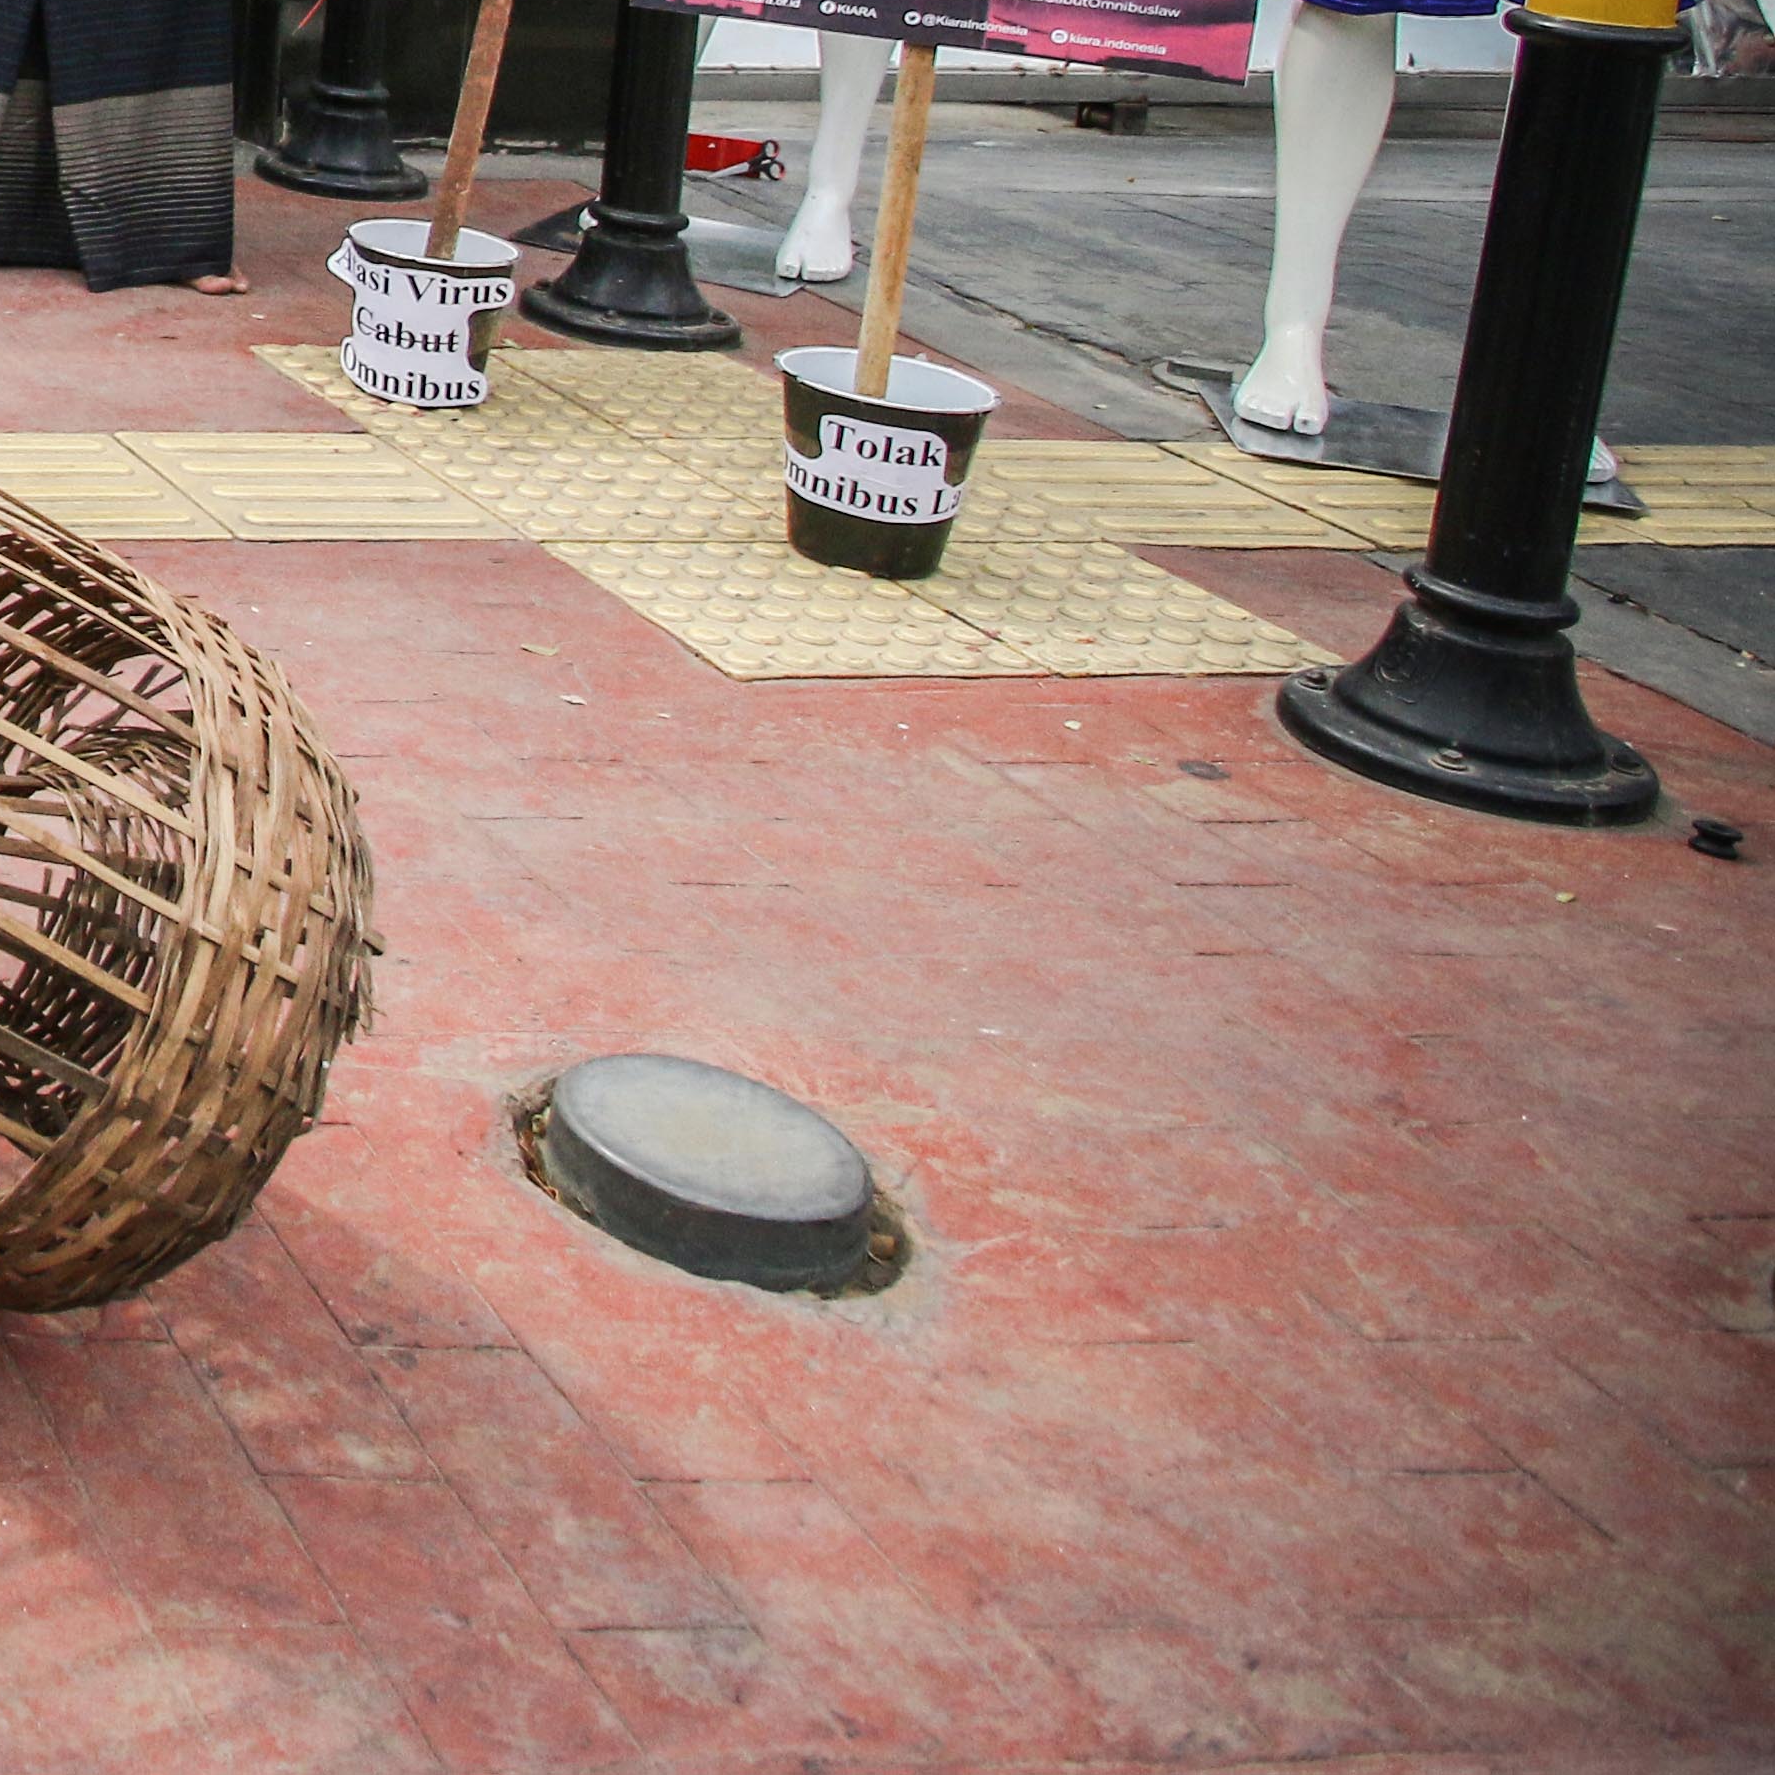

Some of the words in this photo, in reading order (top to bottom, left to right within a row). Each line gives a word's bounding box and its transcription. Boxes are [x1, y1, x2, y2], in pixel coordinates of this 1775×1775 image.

[405, 273, 509, 305] Virus
[356, 306, 458, 353] Cabut
[343, 342, 481, 401] Omnibus
[826, 421, 946, 467] Tolak
